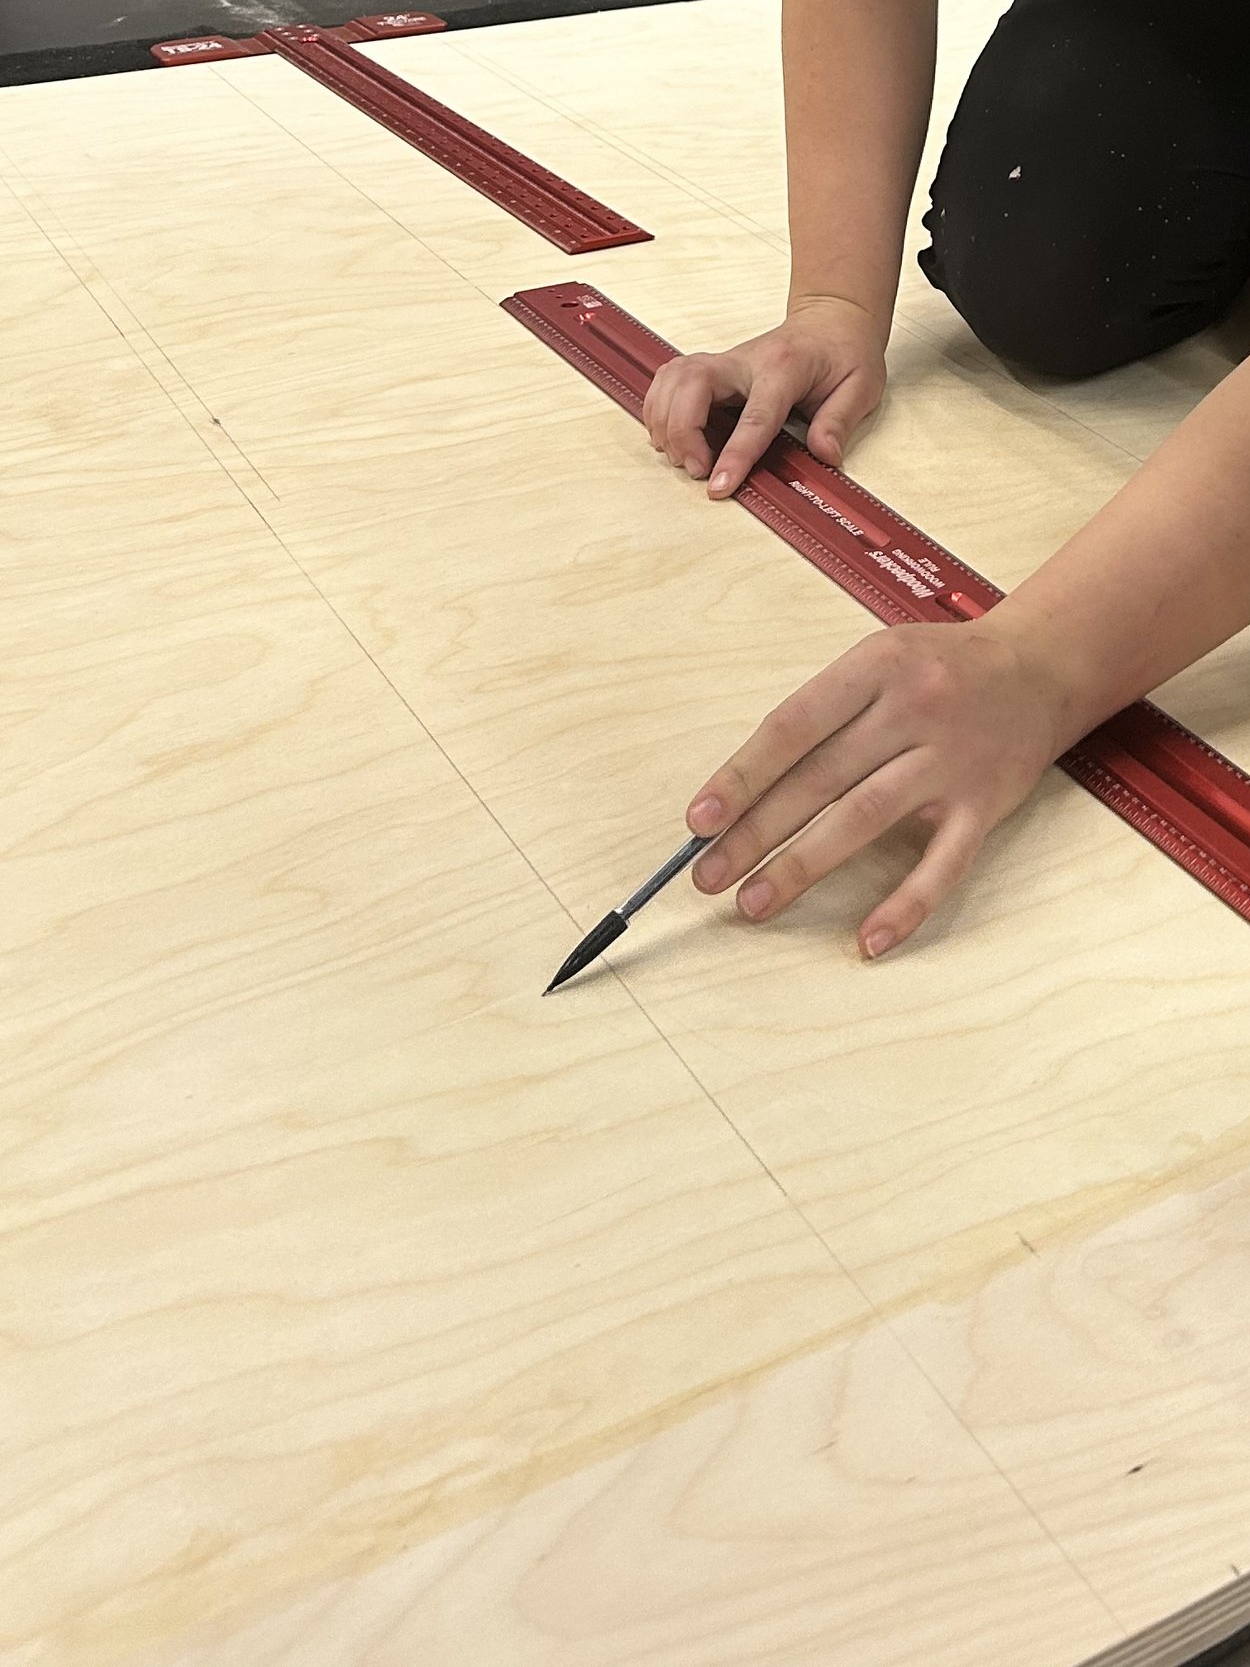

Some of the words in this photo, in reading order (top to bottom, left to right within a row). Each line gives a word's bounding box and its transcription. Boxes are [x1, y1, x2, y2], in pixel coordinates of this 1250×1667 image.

[836, 516, 864, 536] SCALE
[867, 550, 935, 598] Woodpeckers
[891, 548, 946, 589] WOODWORKING
[918, 557, 941, 573] RULE
